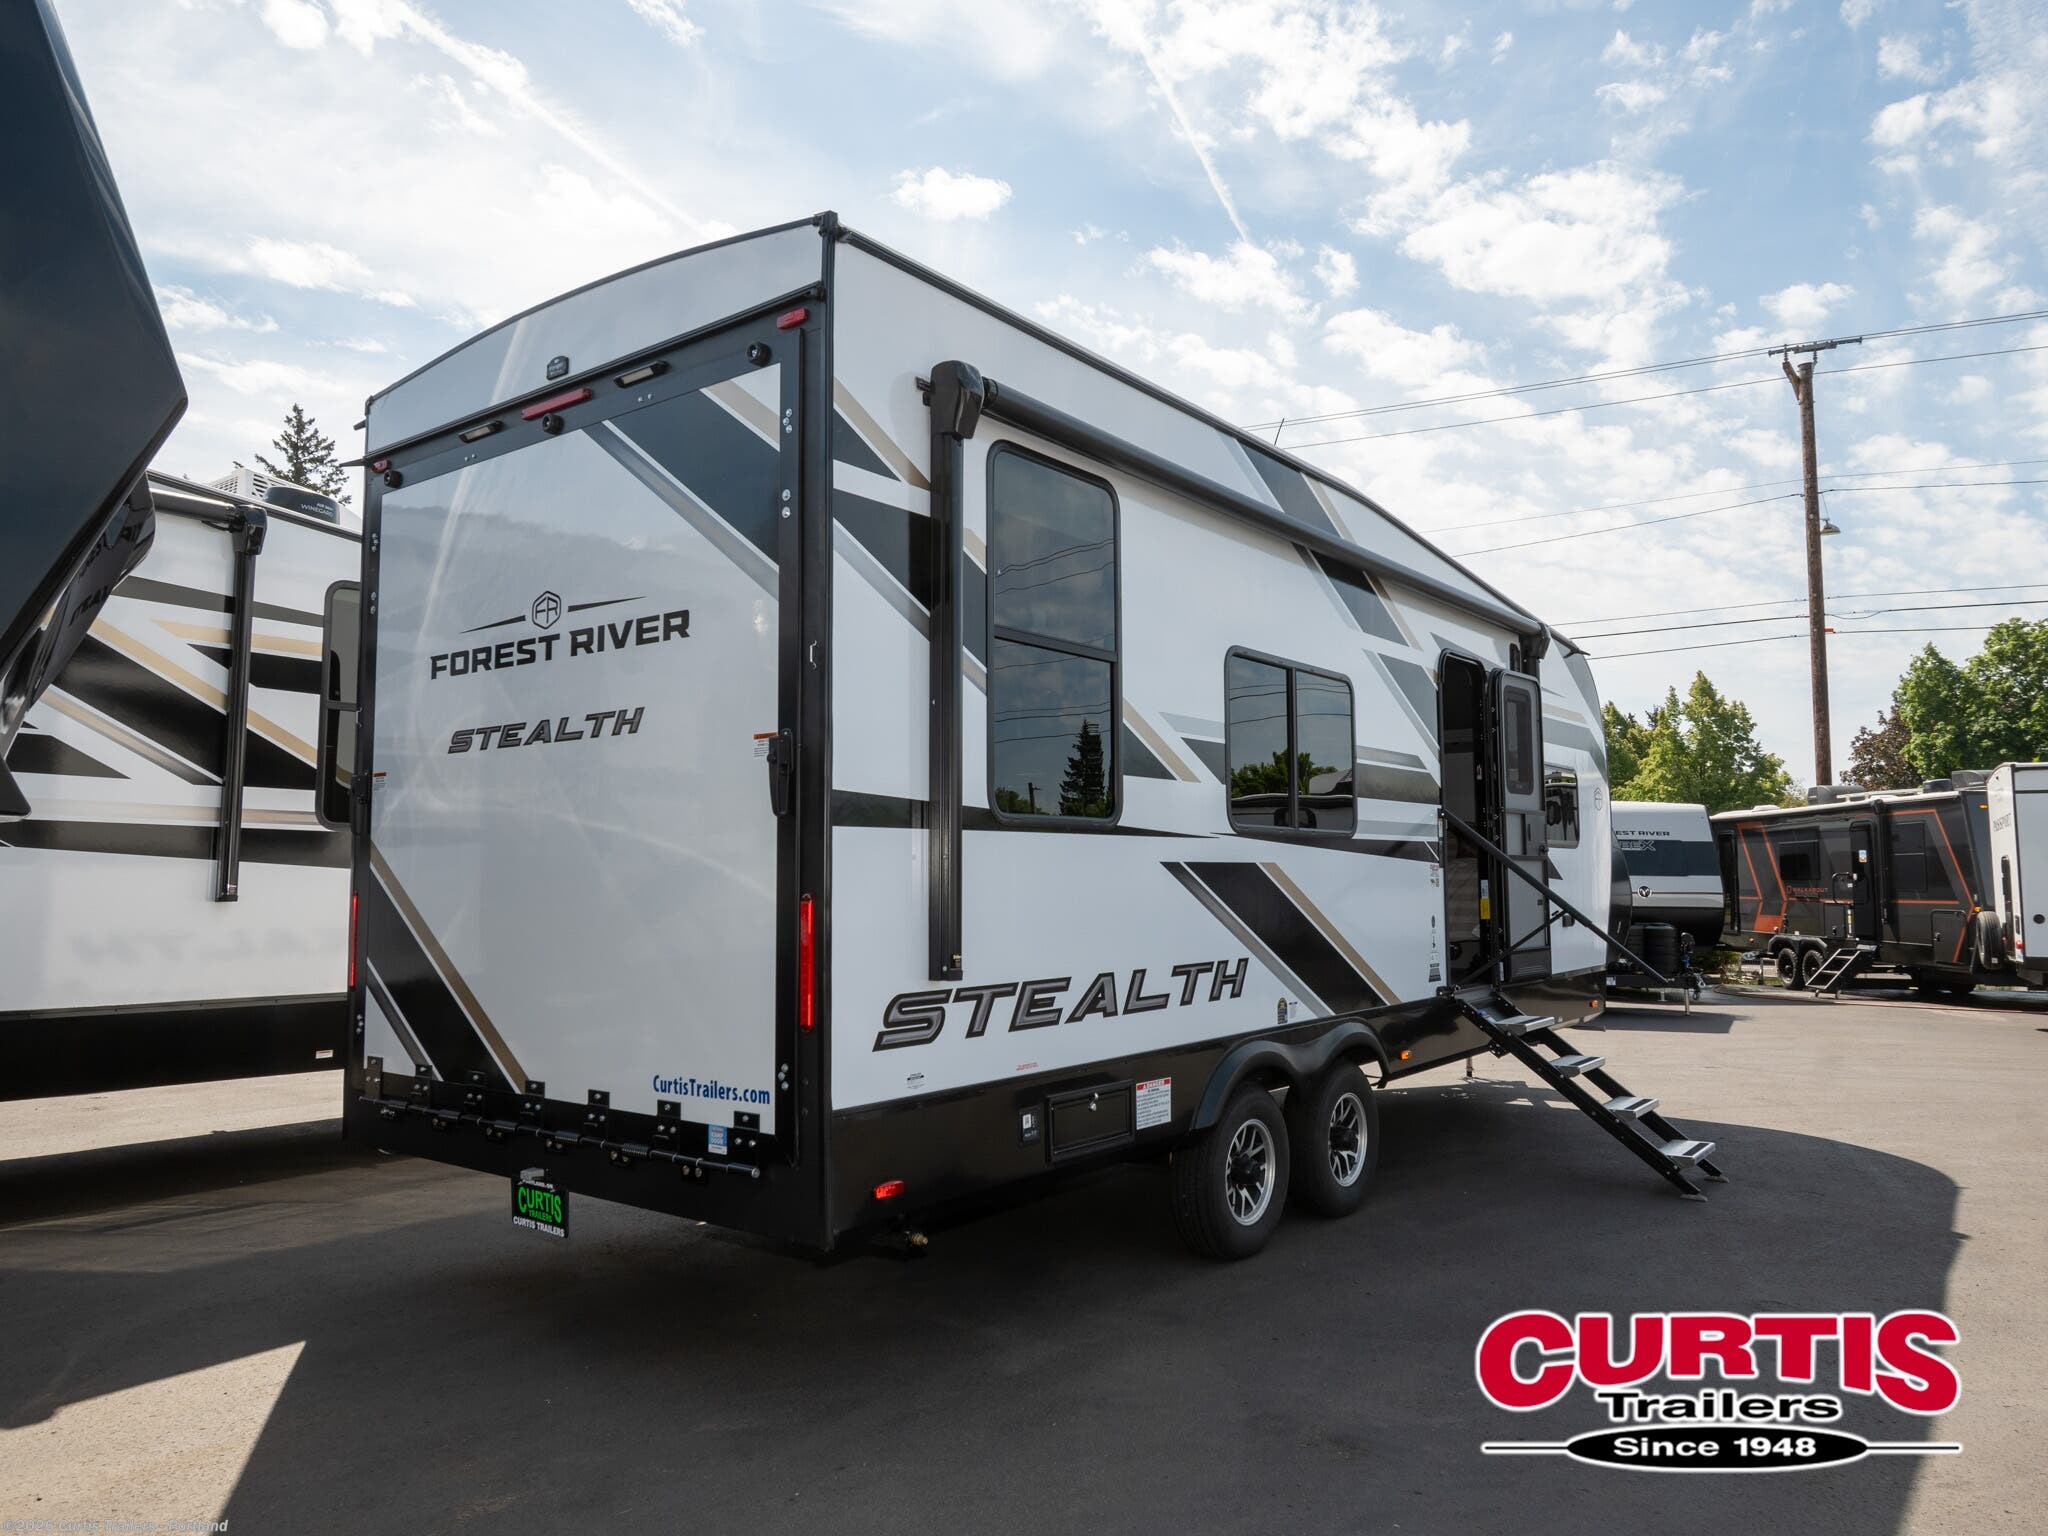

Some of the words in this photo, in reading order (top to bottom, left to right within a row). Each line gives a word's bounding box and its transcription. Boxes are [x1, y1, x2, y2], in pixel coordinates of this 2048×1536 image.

[430, 633, 561, 680] FOREST
[568, 609, 690, 657] RIVER
[447, 706, 646, 754] STEALTH
[872, 957, 1250, 1052] STEALTH
[653, 1074, 771, 1105] CurtisTrailers.com
[518, 1186, 563, 1224] CURTIS
[528, 1209, 553, 1223] TRAILERS
[513, 1215, 536, 1229] CURTIS
[536, 1222, 565, 1238] TRAILERS
